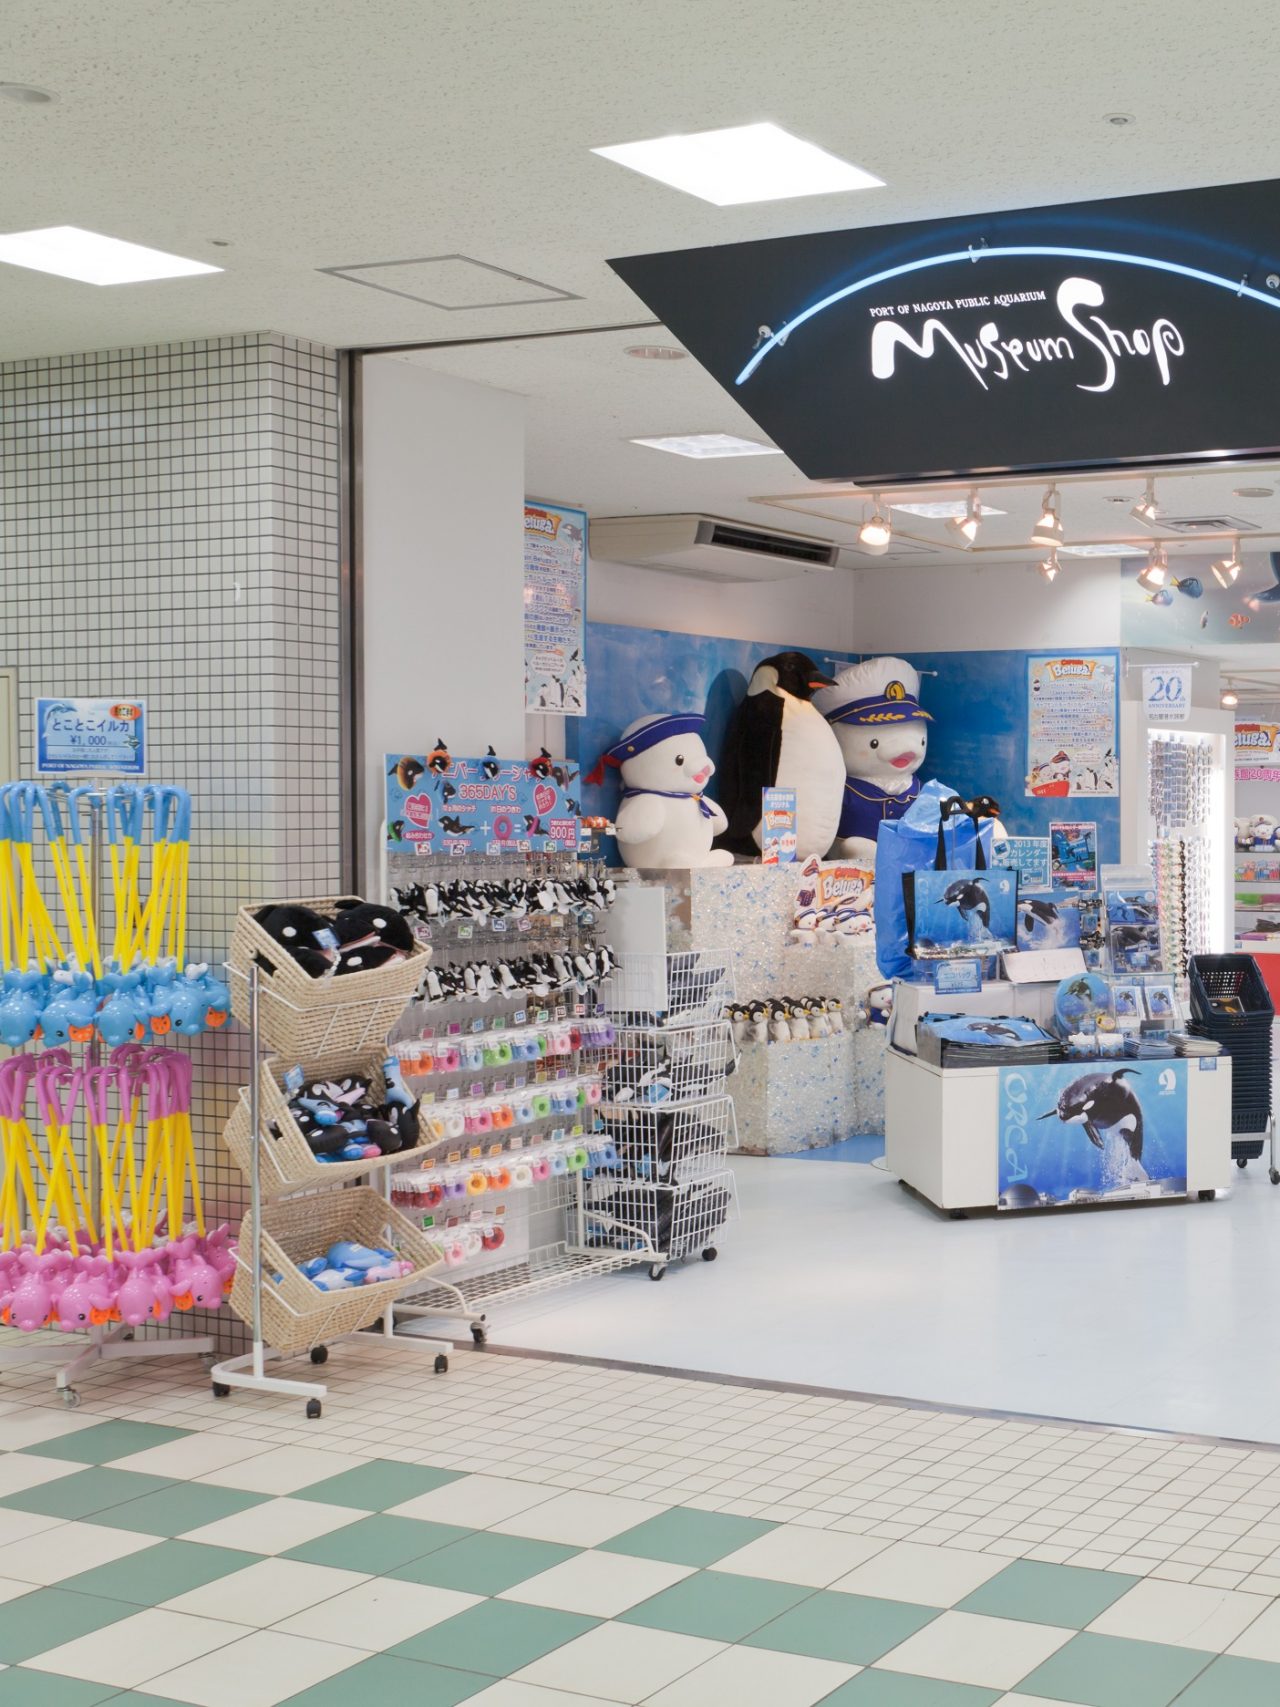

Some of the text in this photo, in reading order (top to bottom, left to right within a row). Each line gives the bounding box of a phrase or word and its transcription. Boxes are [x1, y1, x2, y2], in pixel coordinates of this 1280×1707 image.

[869, 290, 1047, 318] PORT OF NAGOYA PUBLIC AQUARIUM
[871, 276, 1185, 393] Museum Shop
[52, 718, 130, 733] とことこイルカ
[459, 783, 518, 801] 365DAY'S
[549, 826, 576, 840] 900円
[1010, 848, 1048, 858] カレンダー
[1004, 1072, 1029, 1183] ORCA
